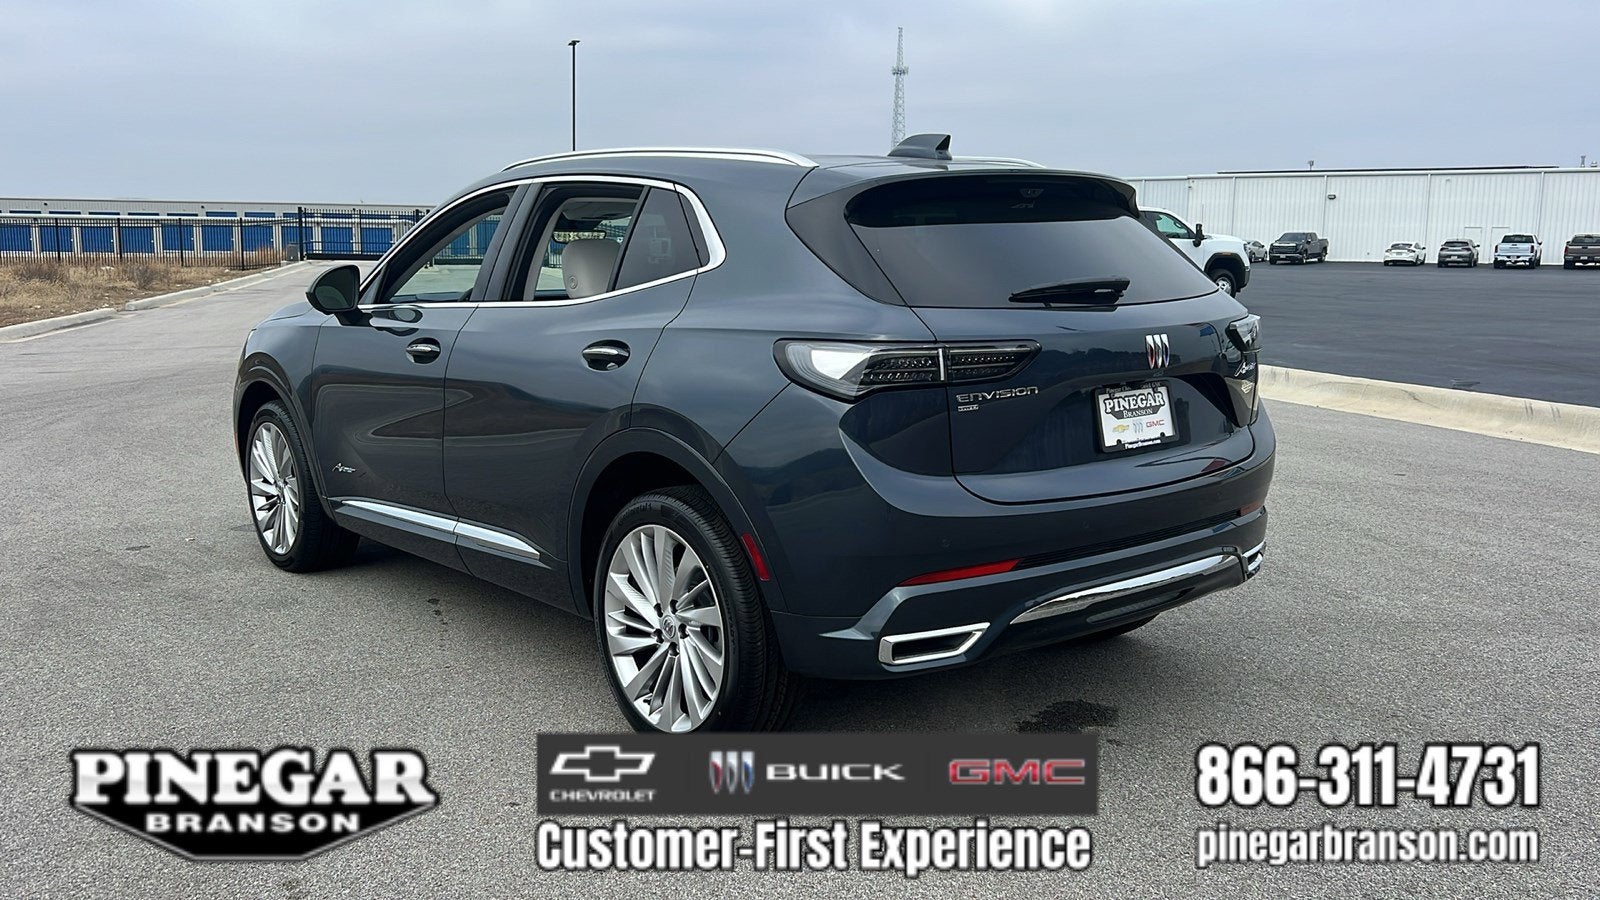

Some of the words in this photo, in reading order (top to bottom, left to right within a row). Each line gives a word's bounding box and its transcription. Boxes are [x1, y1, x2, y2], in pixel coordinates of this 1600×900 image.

[956, 386, 1038, 403] ENVISION
[1104, 392, 1165, 413] PINEGAR
[1145, 419, 1165, 428] GMC
